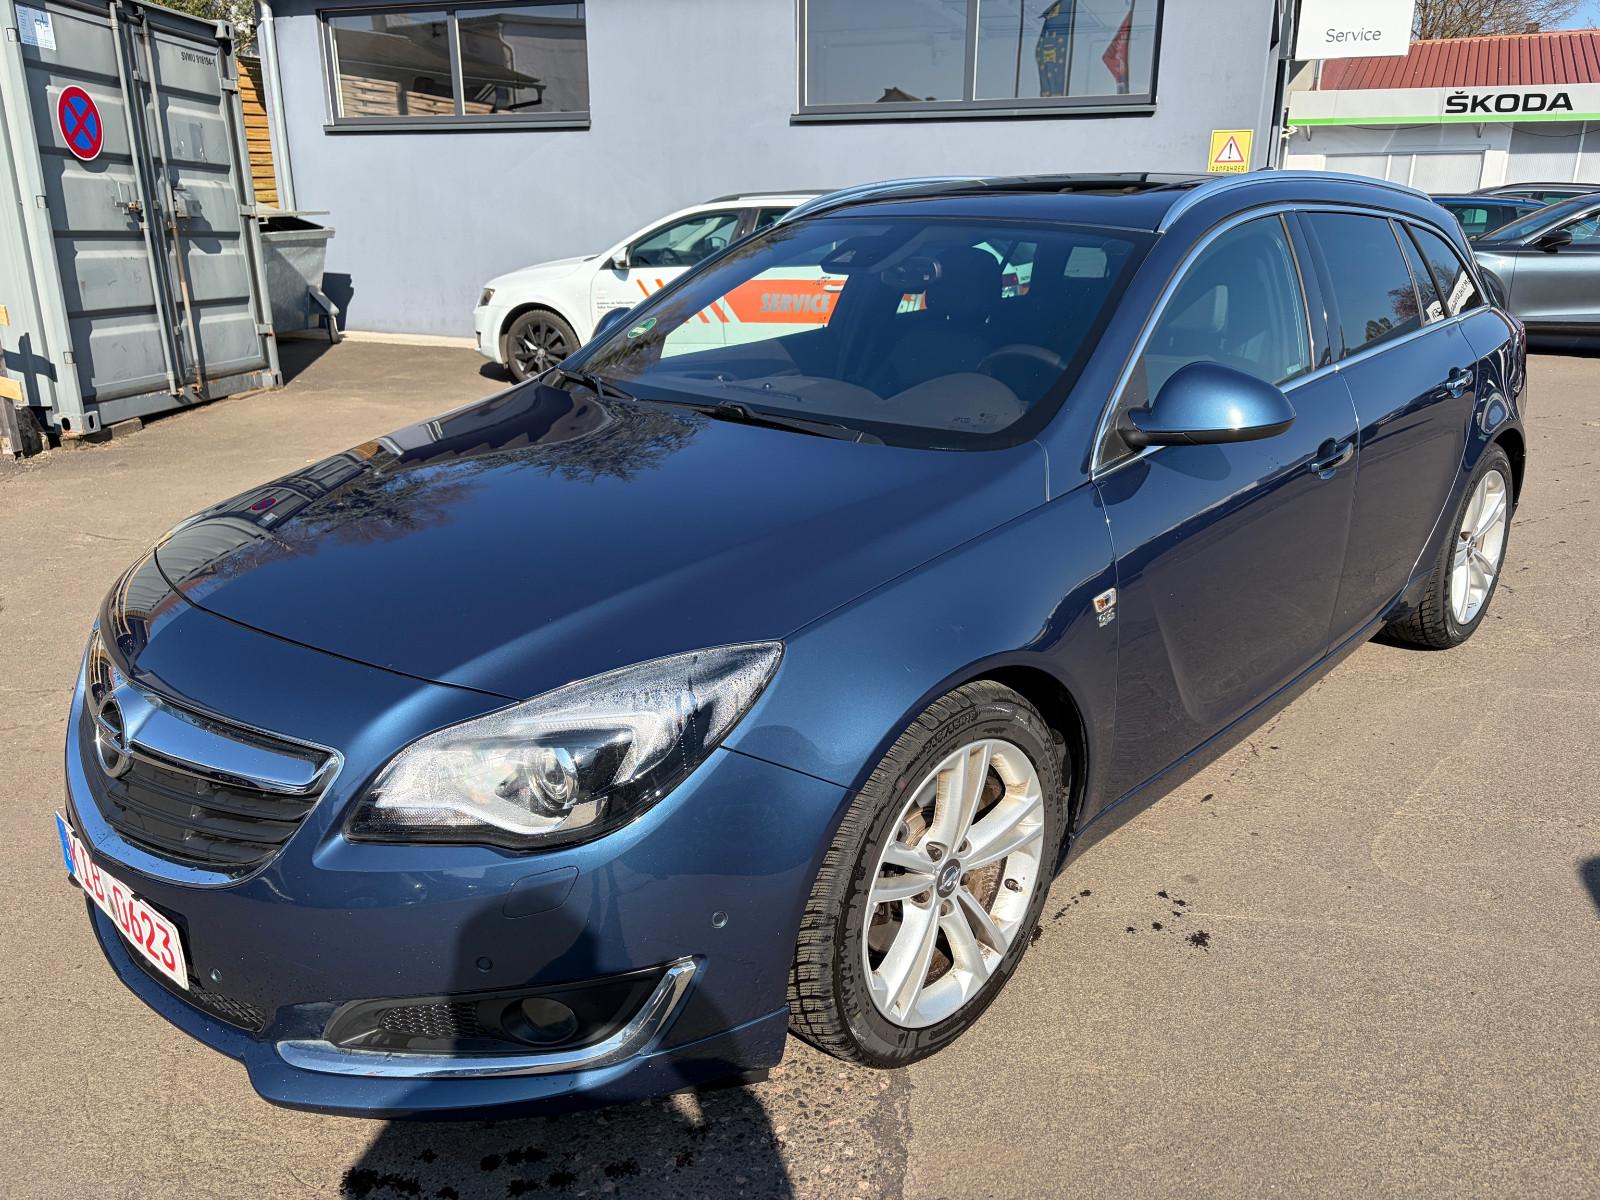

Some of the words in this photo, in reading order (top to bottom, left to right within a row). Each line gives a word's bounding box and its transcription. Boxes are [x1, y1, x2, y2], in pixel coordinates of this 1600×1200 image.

[1325, 27, 1381, 43] Service
[1445, 90, 1573, 114] ŠKODA
[759, 292, 831, 314] SERVICE
[113, 885, 176, 972] 0623
